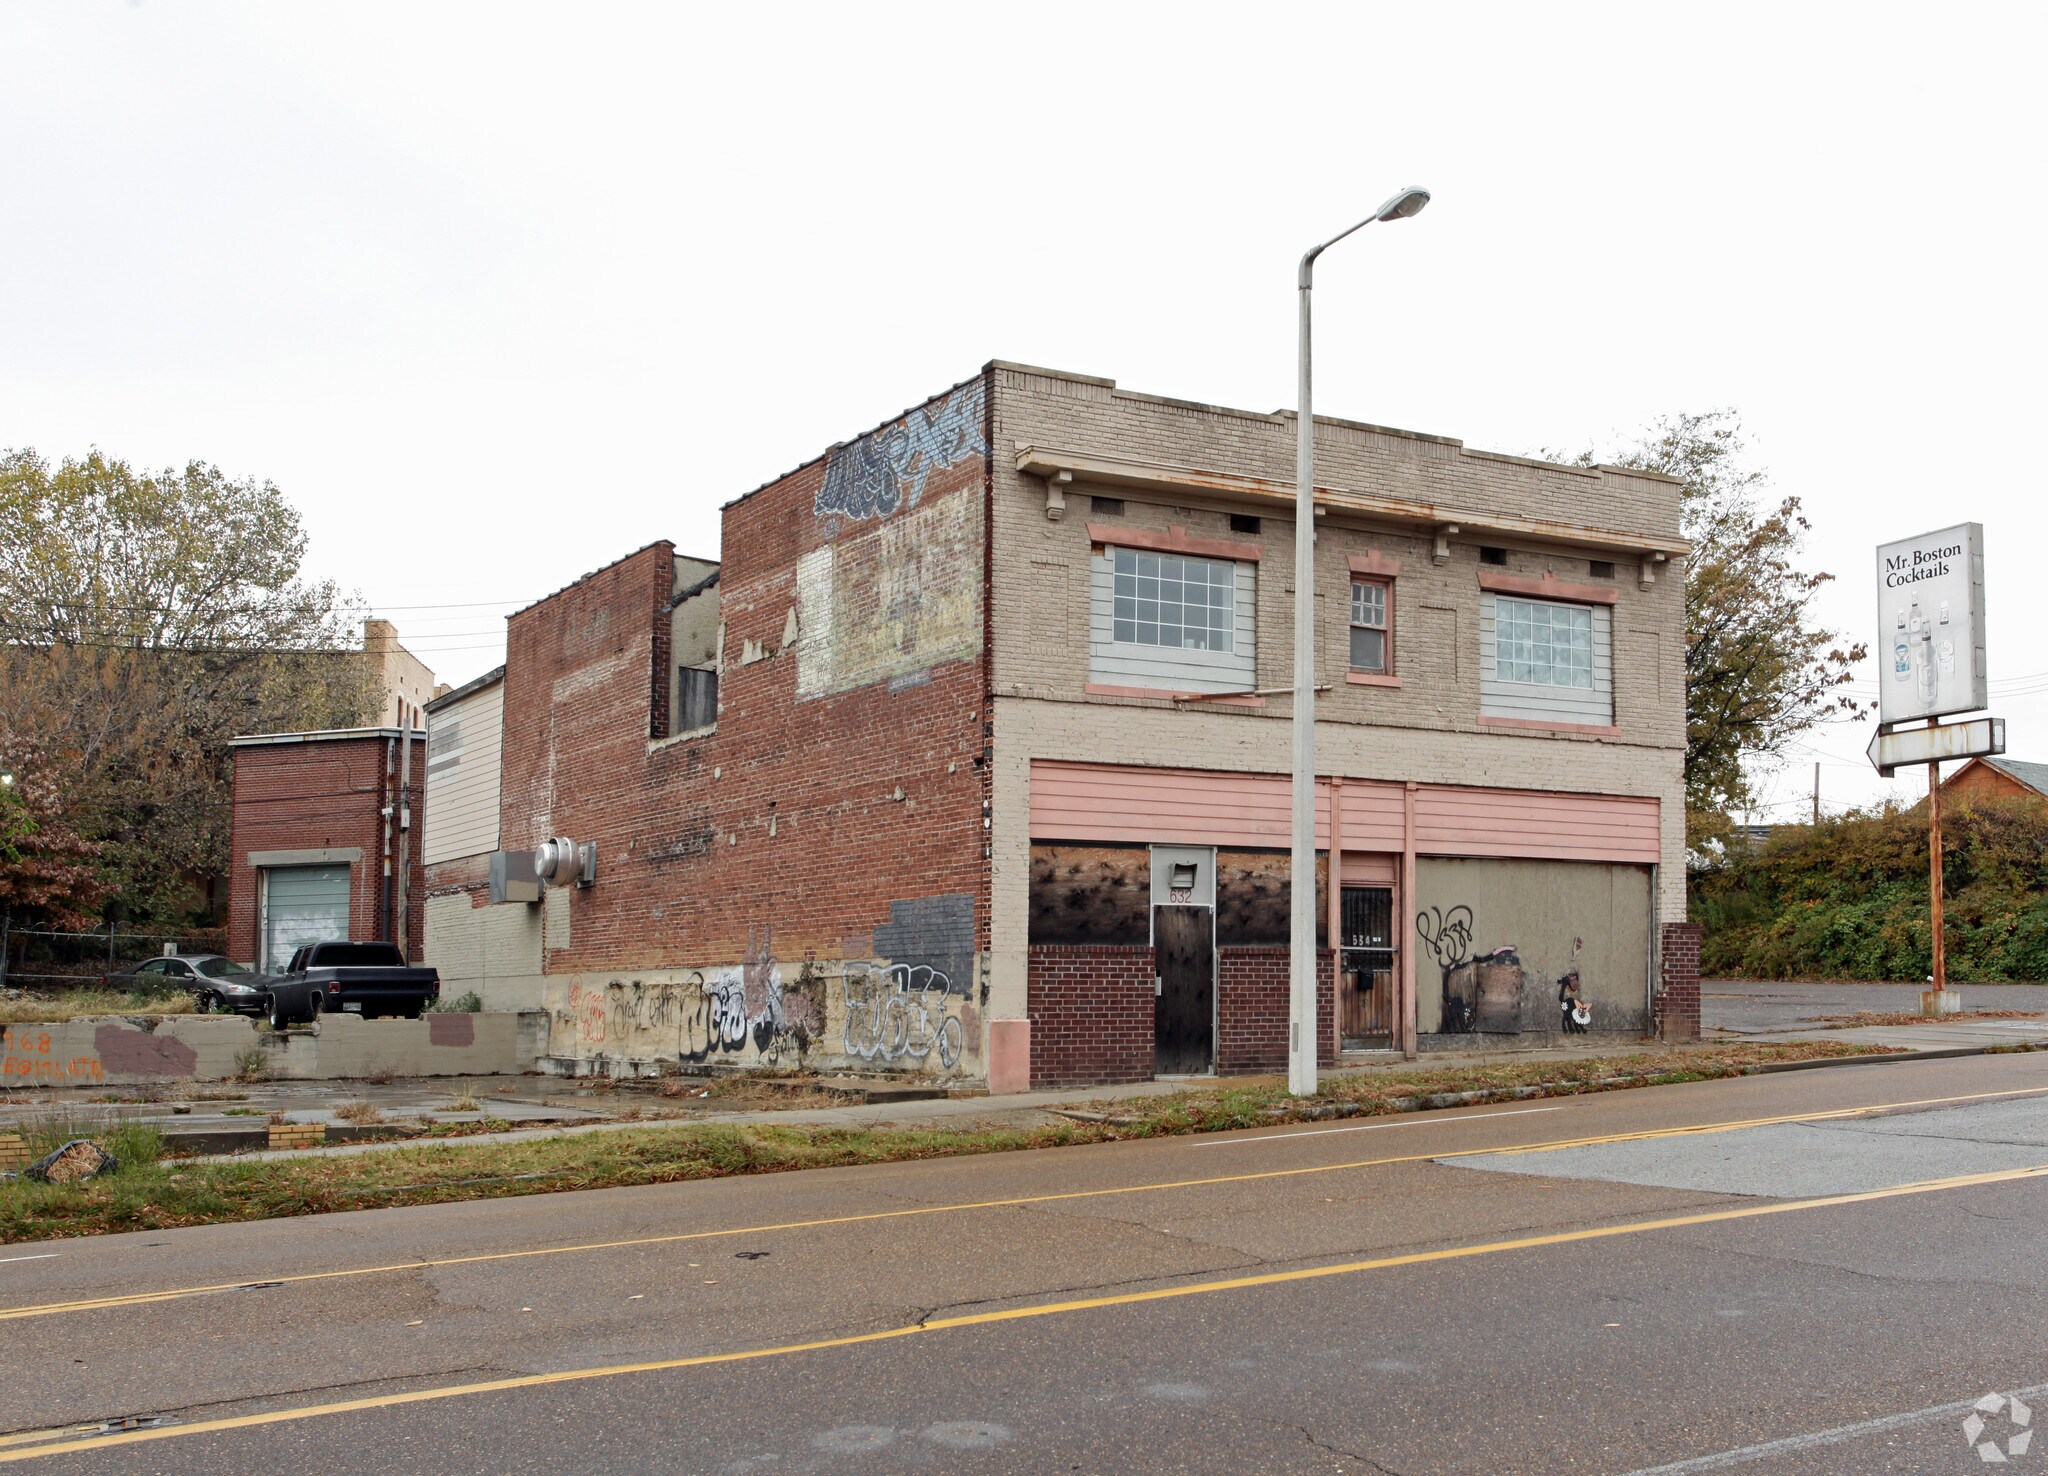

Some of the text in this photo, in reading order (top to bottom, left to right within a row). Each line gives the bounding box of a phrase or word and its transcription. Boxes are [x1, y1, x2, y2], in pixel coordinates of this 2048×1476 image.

[1886, 544, 1961, 572] Mr. Boston
[1886, 561, 1949, 588] Cocktails
[1170, 889, 1192, 904] 632
